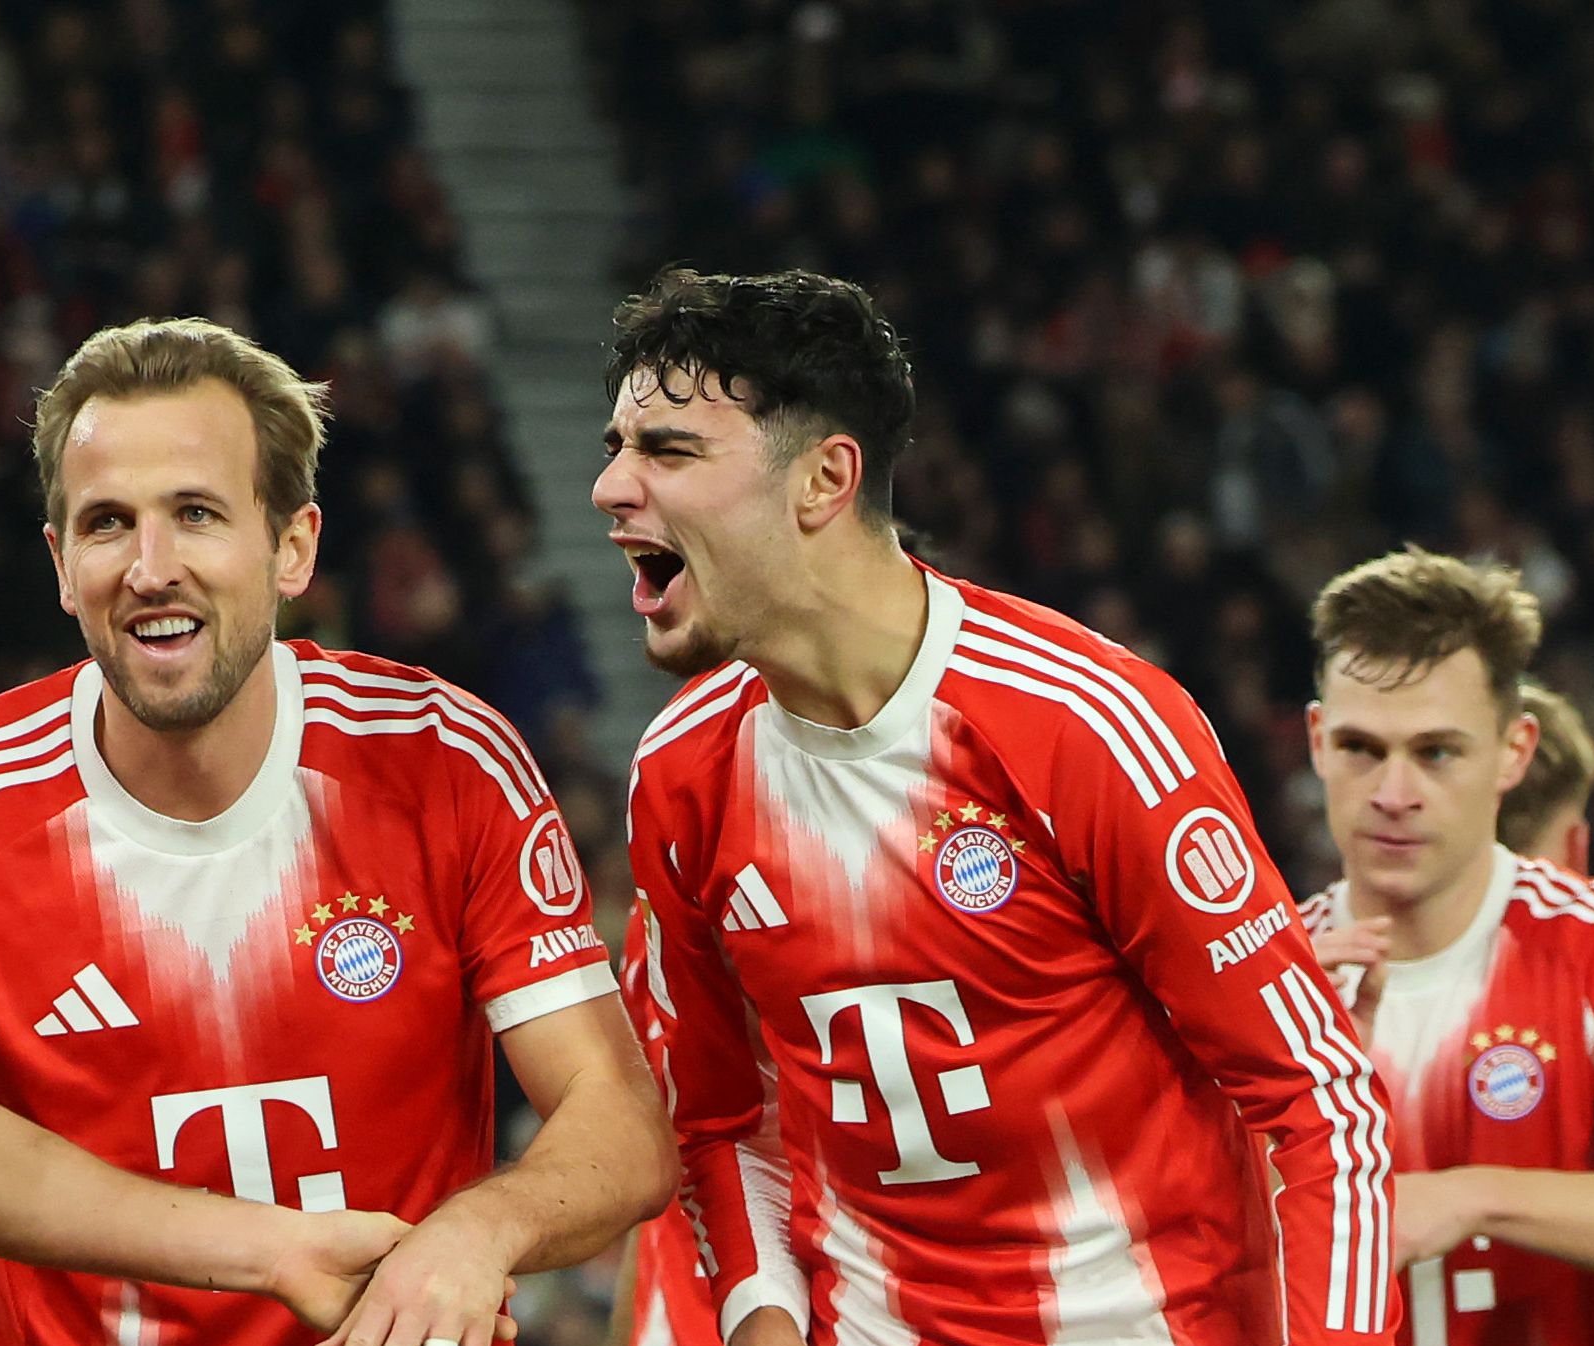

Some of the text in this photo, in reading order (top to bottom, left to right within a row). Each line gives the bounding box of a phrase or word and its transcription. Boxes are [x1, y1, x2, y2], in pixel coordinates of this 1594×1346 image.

[942, 833, 1008, 867] FC BAYERN
[323, 924, 393, 958] FC BAYERN
[1206, 901, 1291, 974] Allianz
[800, 980, 991, 1185] T
